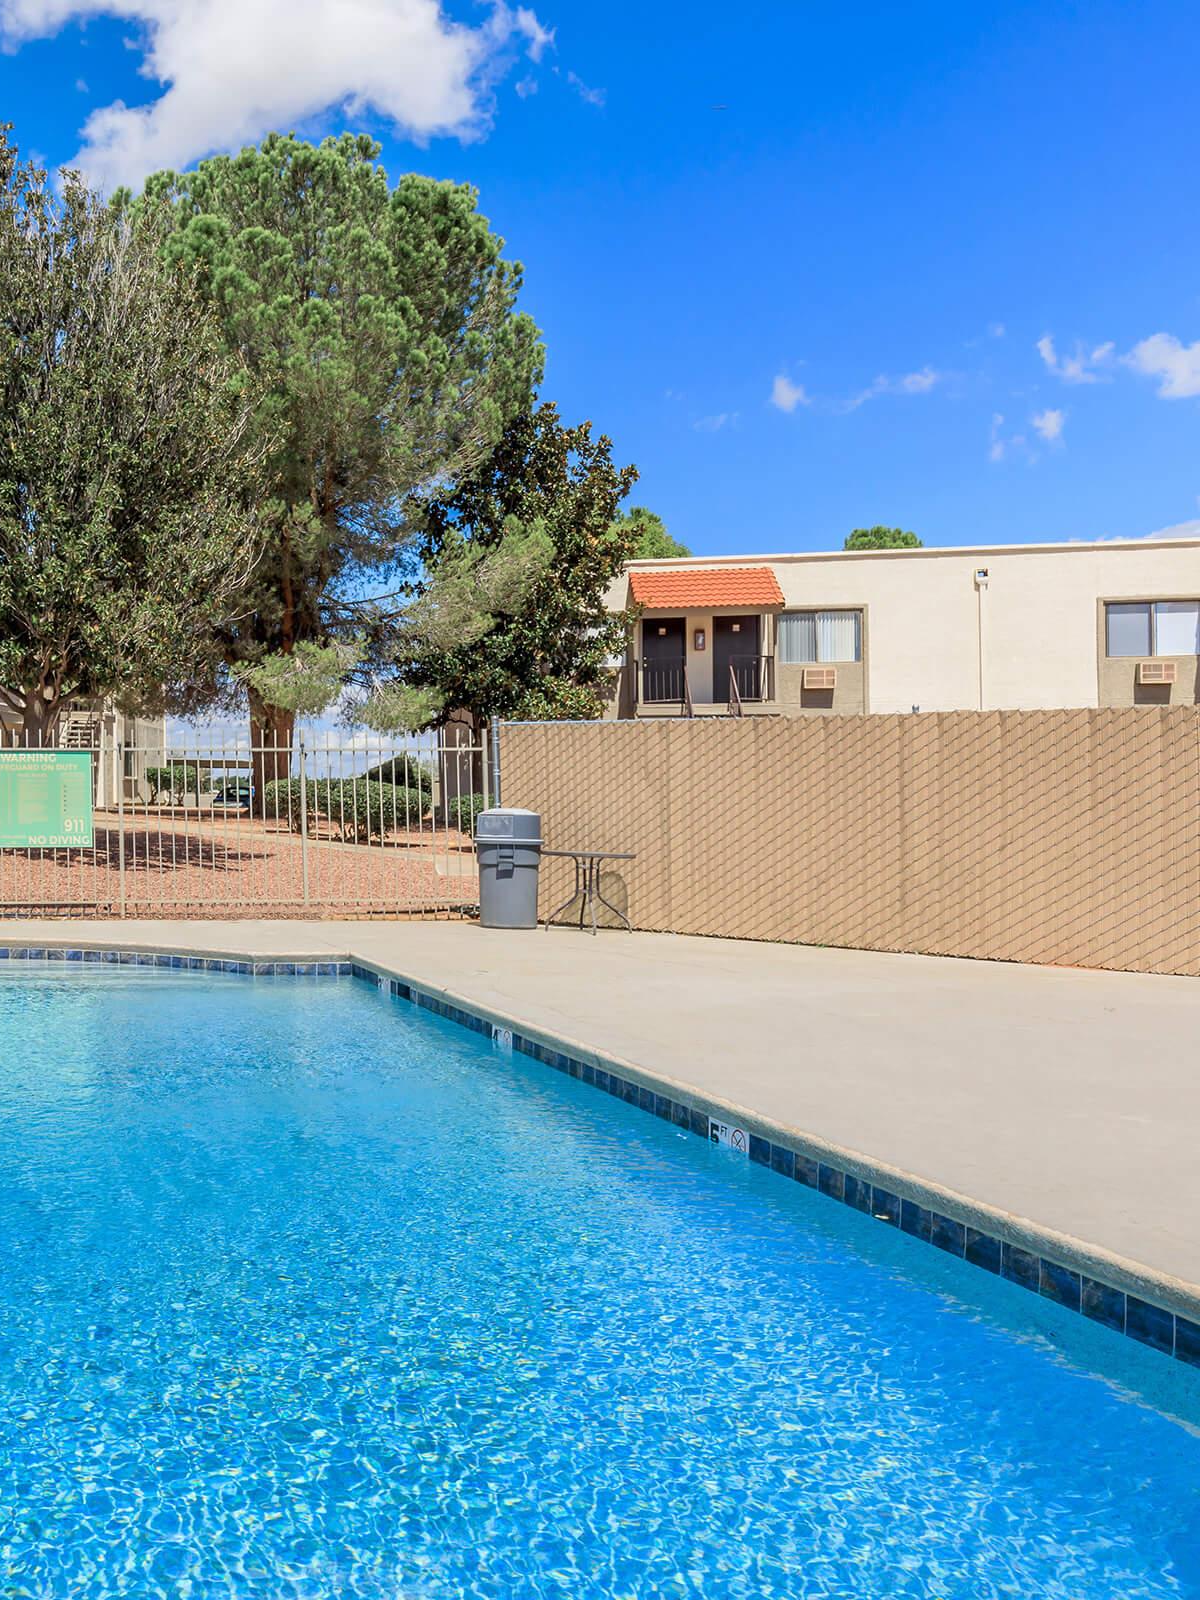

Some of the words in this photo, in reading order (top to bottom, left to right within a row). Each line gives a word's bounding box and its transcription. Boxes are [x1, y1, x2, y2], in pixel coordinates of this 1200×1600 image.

[0, 753, 56, 762] WARNING
[64, 818, 84, 832] 911
[28, 835, 47, 845] NO
[49, 835, 90, 845] DIVING
[711, 1122, 719, 1144] 5
